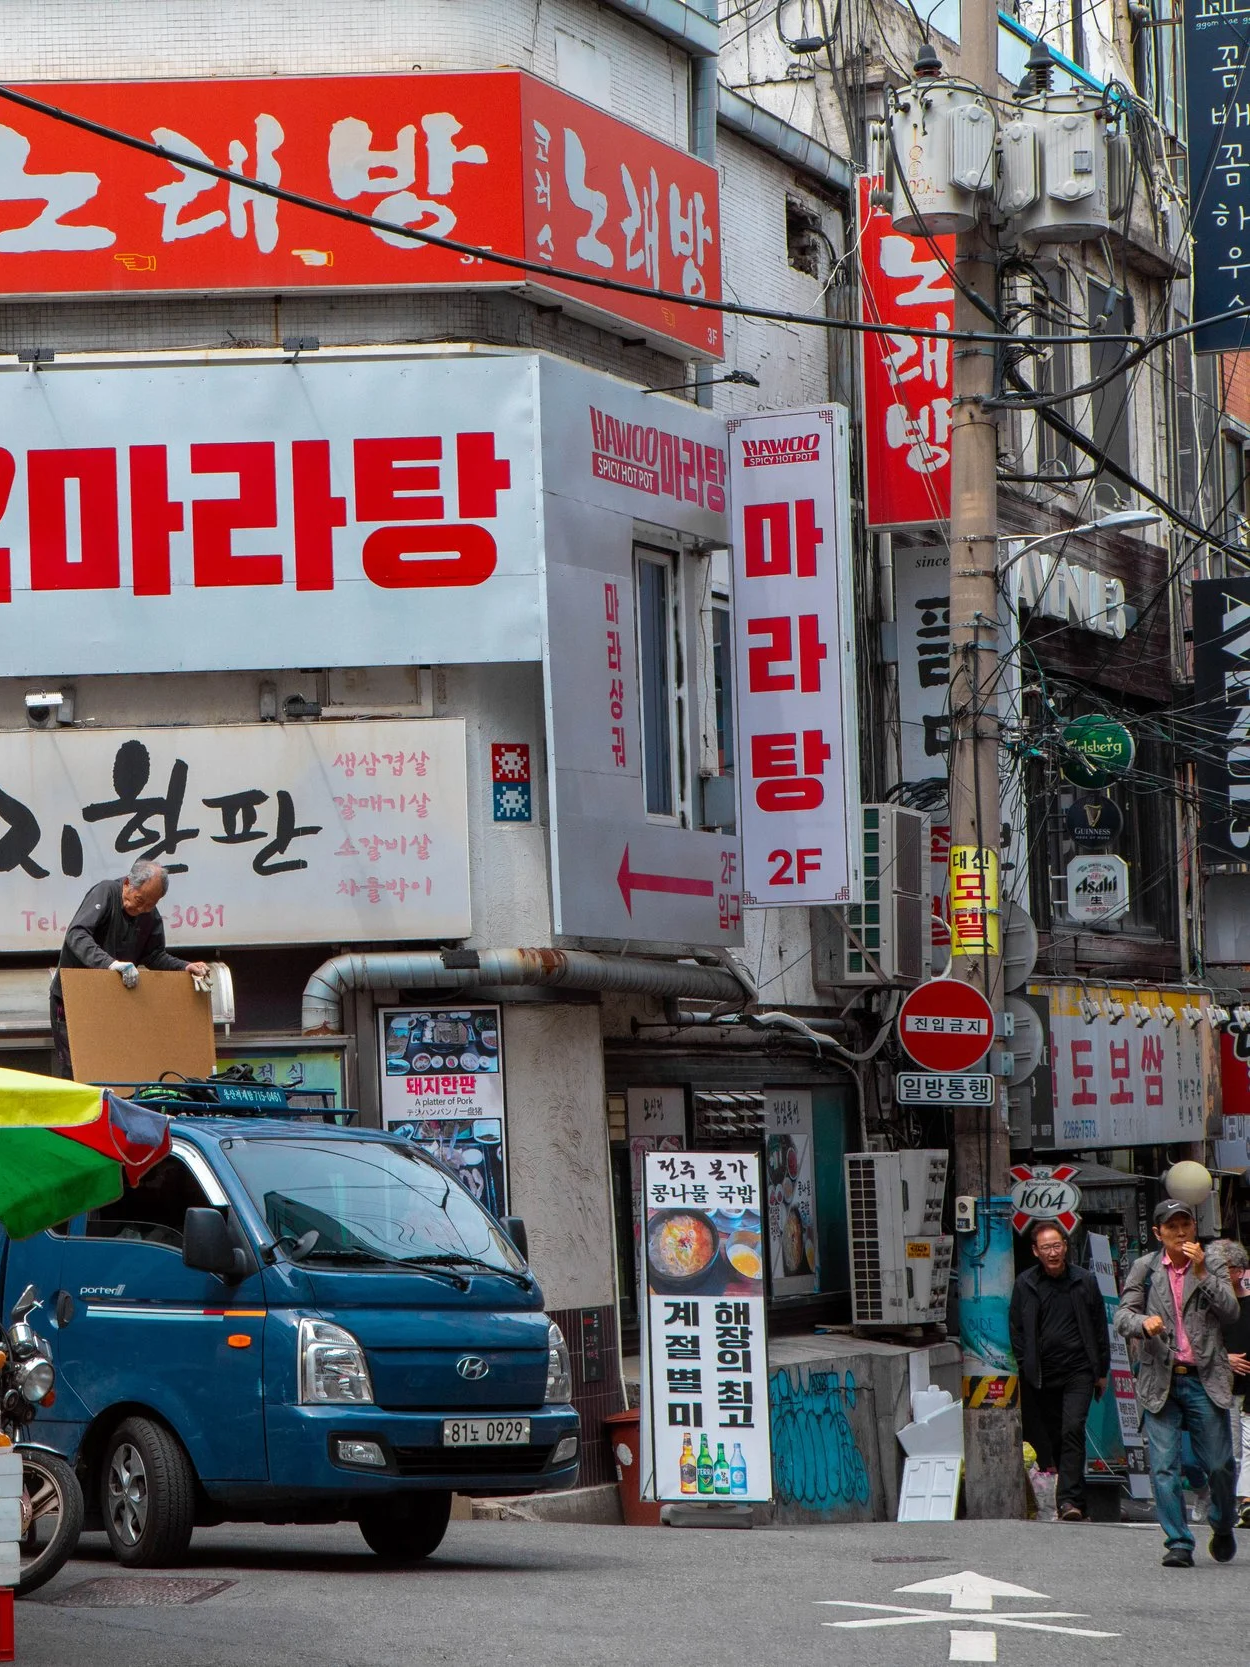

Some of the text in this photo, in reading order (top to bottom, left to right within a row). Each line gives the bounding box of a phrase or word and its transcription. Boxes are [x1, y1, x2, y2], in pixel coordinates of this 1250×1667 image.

[564, 126, 715, 311] 노래방
[706, 327, 718, 346] 3F
[878, 235, 955, 475] 노래방
[589, 404, 661, 468] HAWOO
[741, 432, 821, 457] HAWOO
[749, 451, 813, 466] SPICY HOT POT
[597, 456, 654, 489] SPICY HOT POT
[659, 430, 728, 515] 마라탕
[27, 431, 512, 596] 마라탕
[743, 497, 832, 813] 마라탕
[604, 582, 627, 768] 마라샹궈
[332, 751, 432, 778] 생삼겹살
[332, 792, 432, 820] 갈매기살
[333, 834, 433, 861] 소갈비살
[952, 850, 990, 871] 대신
[720, 851, 737, 885] 2F
[767, 848, 823, 886] 2F
[1075, 875, 1118, 894] Asahi
[718, 892, 742, 931] 입구
[953, 873, 991, 939] 모텔
[913, 1016, 982, 1034] 진입금지
[405, 1075, 477, 1096] 돼지한판
[902, 1077, 990, 1102] 일방통행
[414, 1096, 474, 1108] A platter of Pork
[657, 1158, 696, 1181] 전주
[650, 1183, 757, 1204] 콩나물 국밥
[1019, 1186, 1069, 1211] 1664
[663, 1301, 704, 1429] 계절별미
[714, 1301, 756, 1429] 해장의 최고
[451, 1421, 523, 1443] 81노 0929
